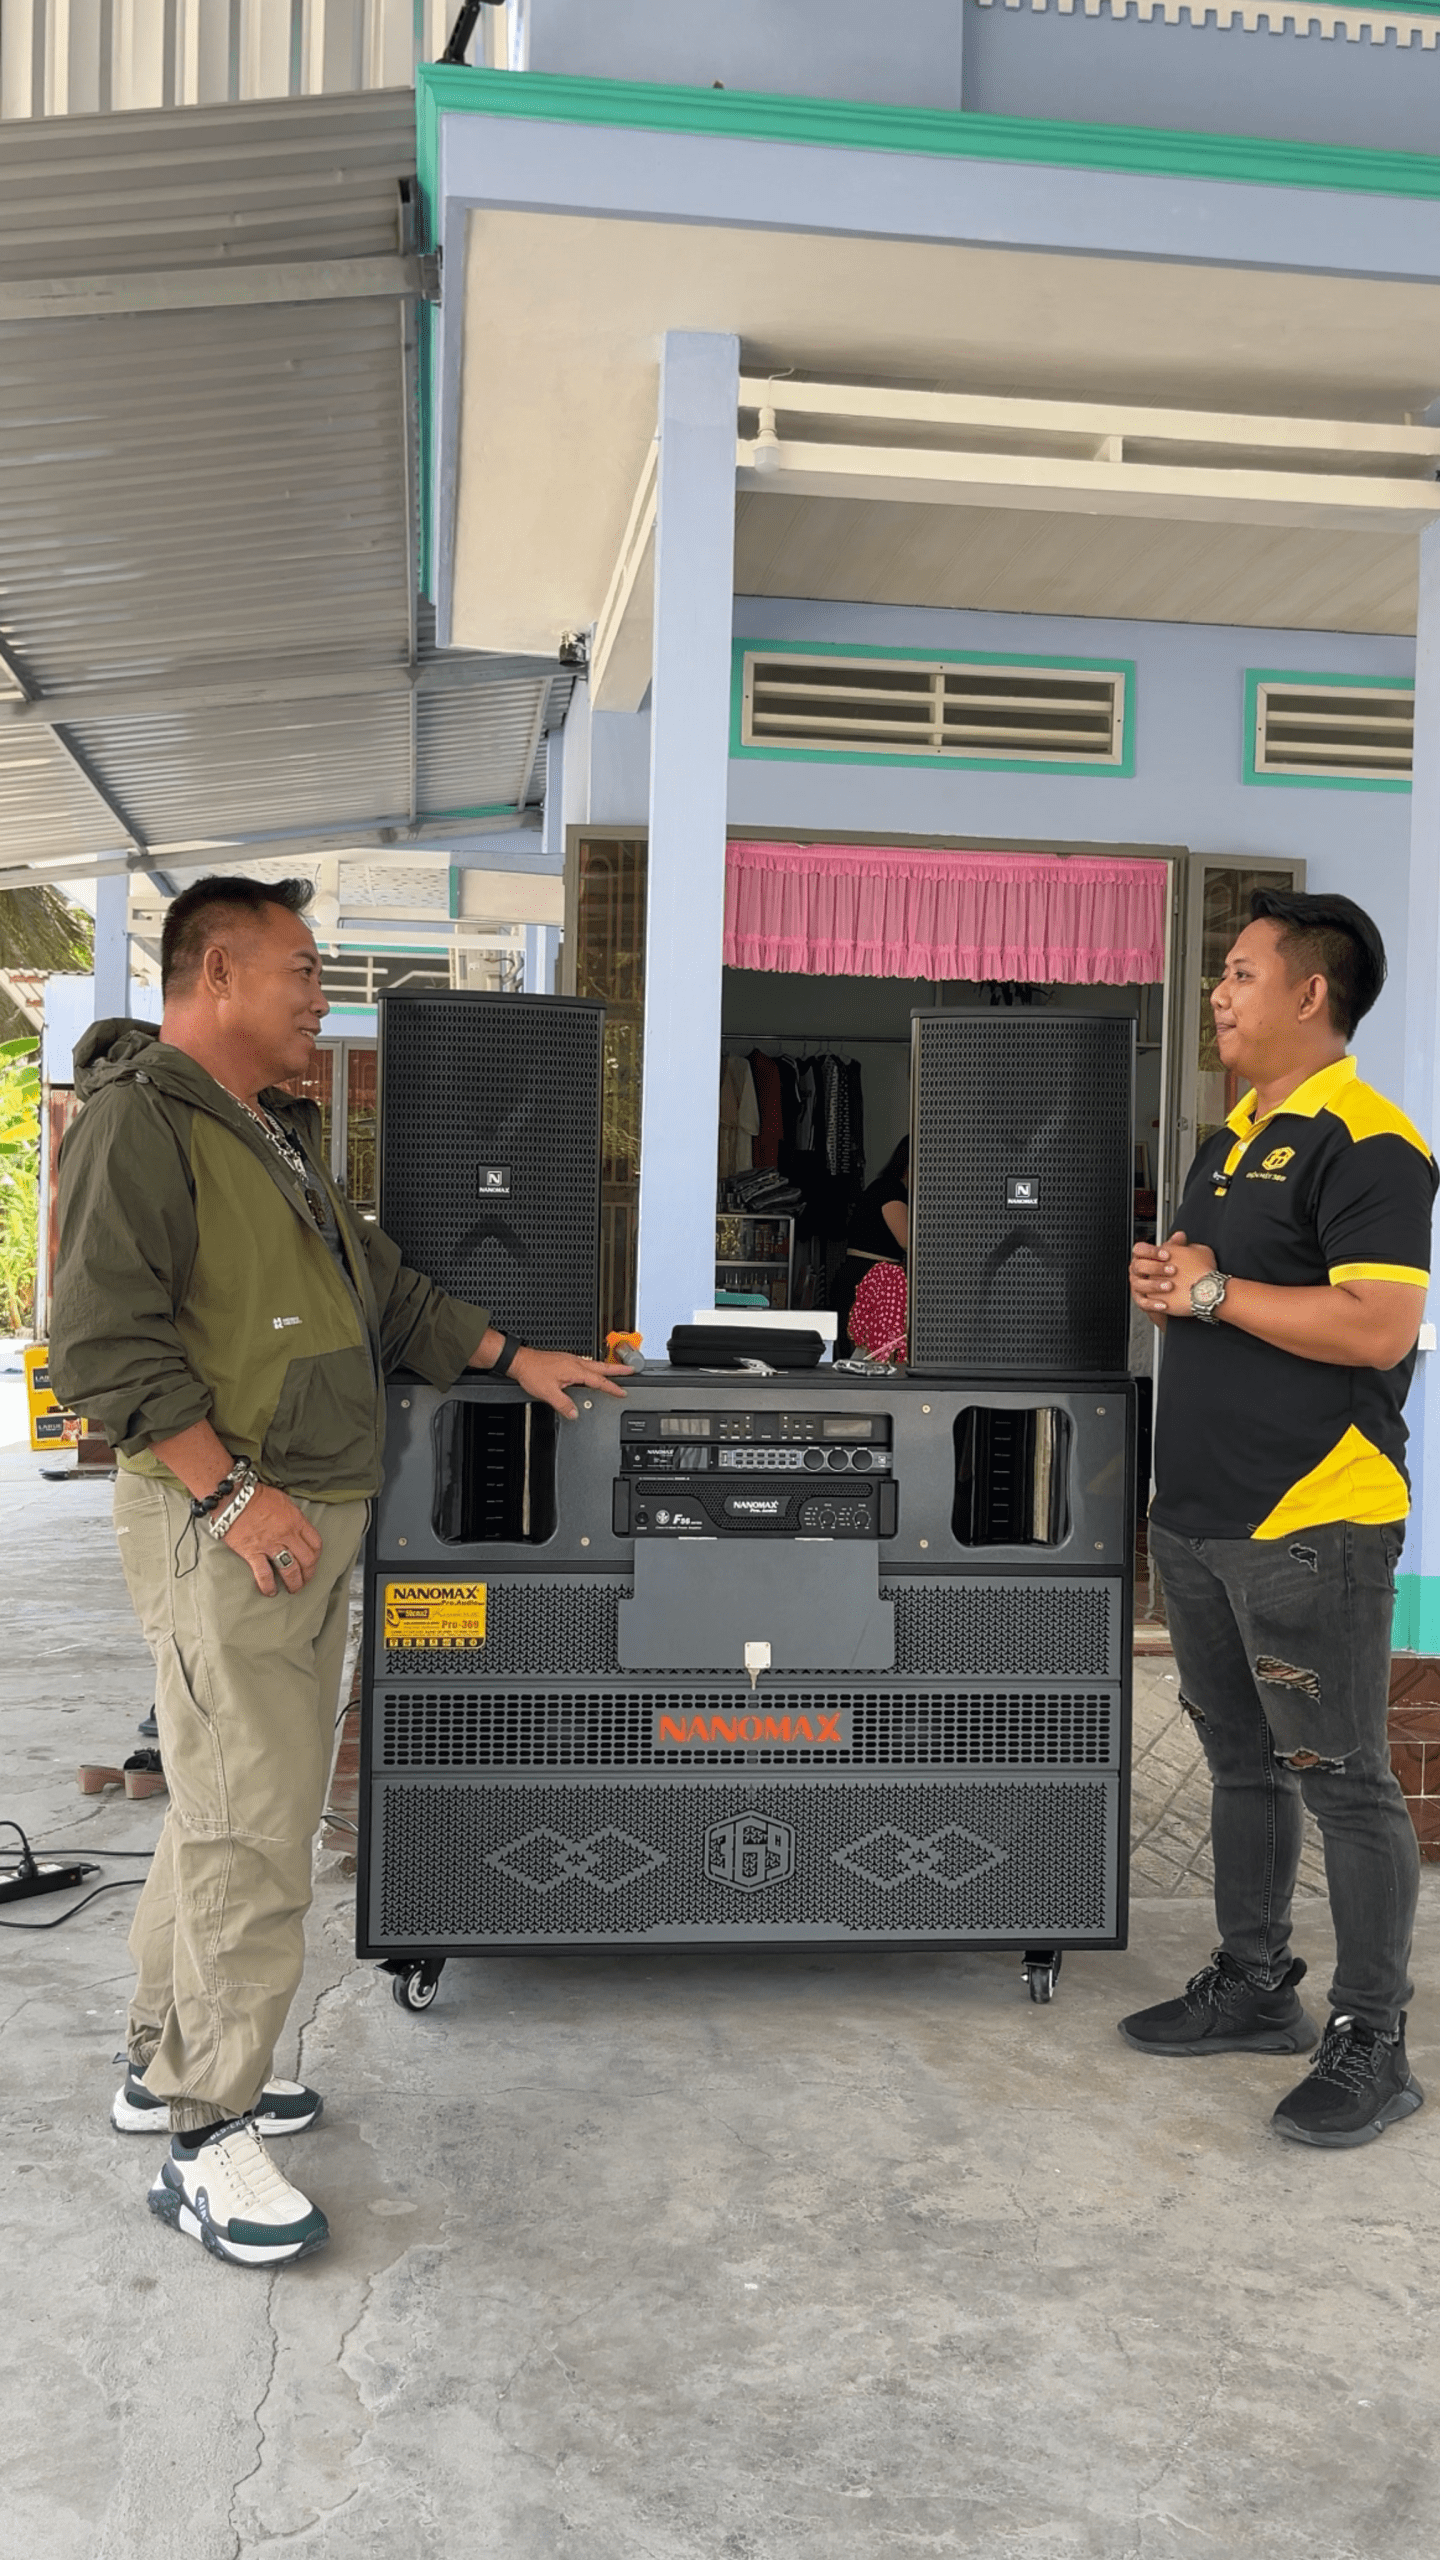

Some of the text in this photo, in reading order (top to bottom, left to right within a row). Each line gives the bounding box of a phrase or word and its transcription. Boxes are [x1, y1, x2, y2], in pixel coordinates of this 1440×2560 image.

[733, 1500, 777, 1509] NANOMAX
[394, 1586, 478, 1600] NANOMAX
[659, 1711, 842, 1743] NANOMAX
